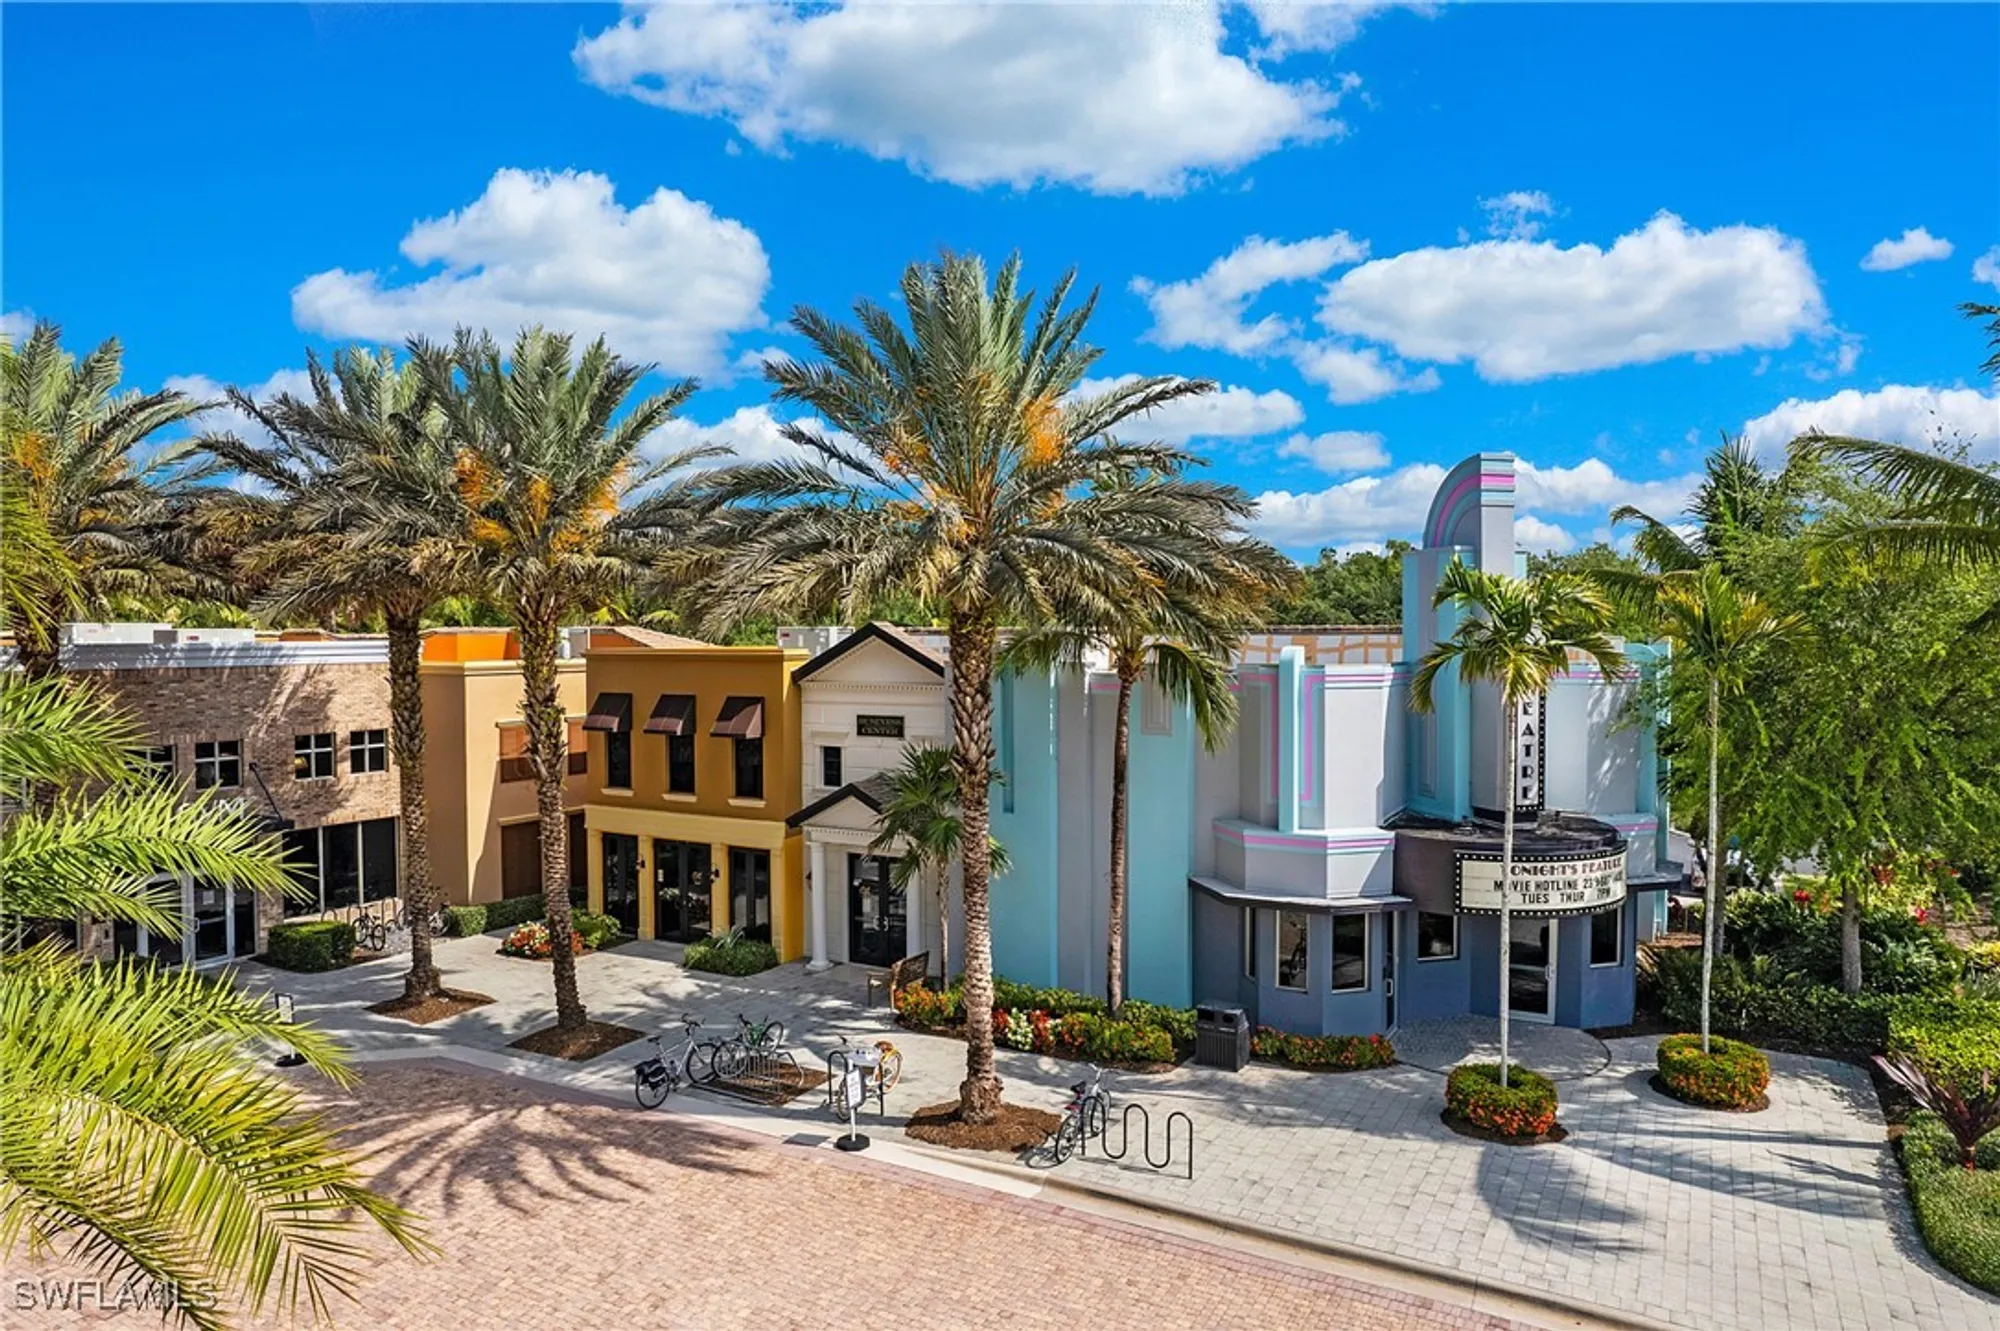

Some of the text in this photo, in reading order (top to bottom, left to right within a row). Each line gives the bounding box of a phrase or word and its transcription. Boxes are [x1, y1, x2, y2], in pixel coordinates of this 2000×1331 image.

[1521, 700, 1535, 800] EATRE
[1500, 863, 1578, 877] ONIGHT'S
[1493, 880, 1578, 892] MVIE HOTLINE
[1521, 893, 1550, 904] TUES
[1560, 891, 1585, 903] THUR
